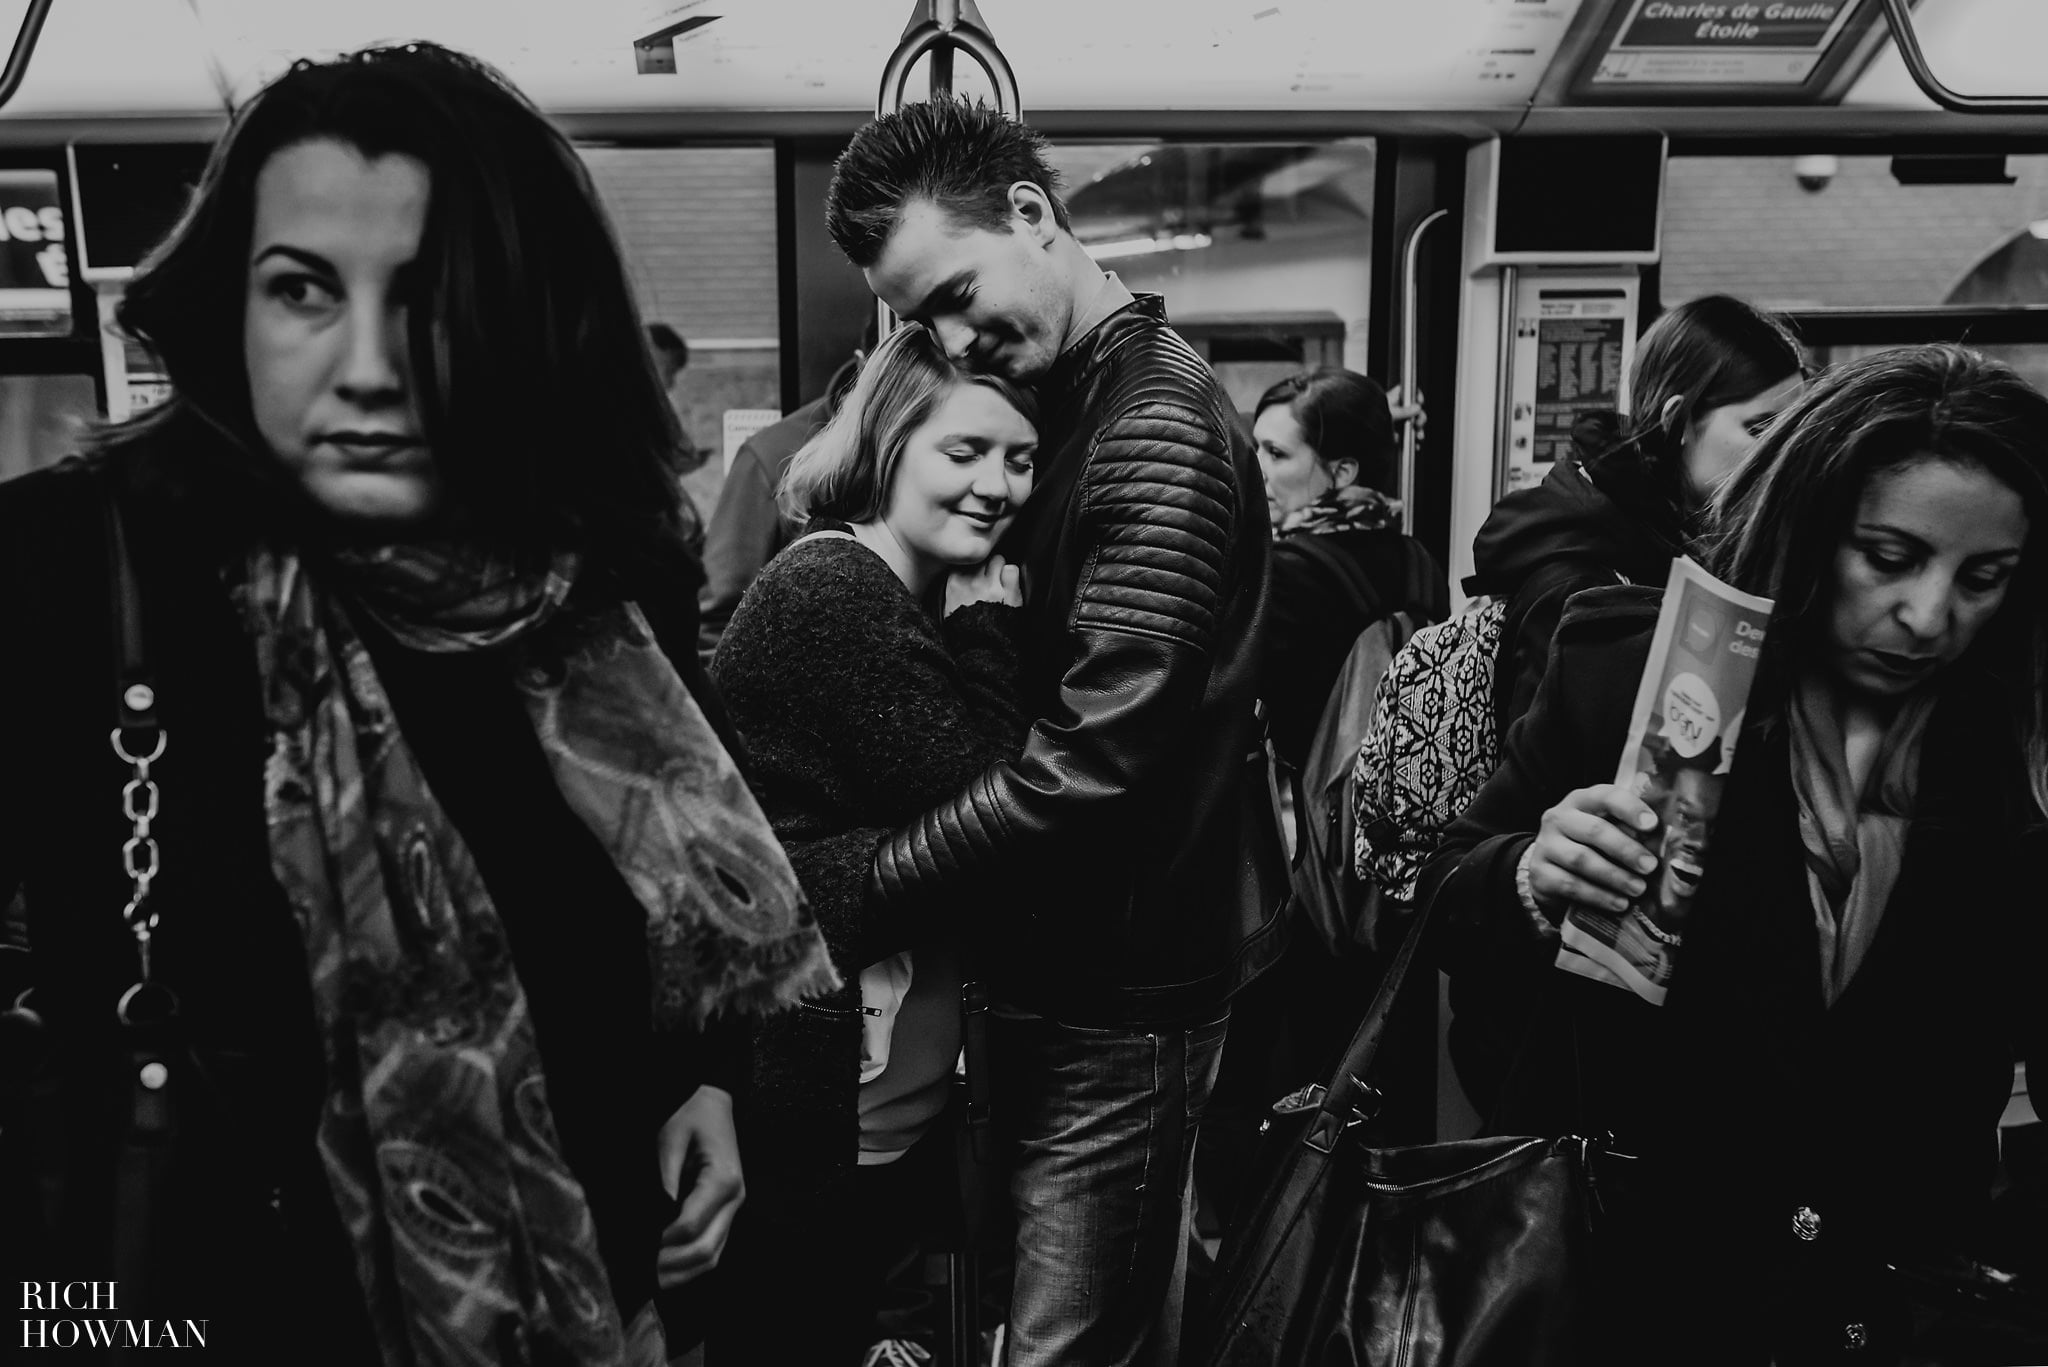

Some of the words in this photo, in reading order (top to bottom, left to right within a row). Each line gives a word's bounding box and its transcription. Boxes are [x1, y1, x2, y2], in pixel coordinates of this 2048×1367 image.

[1645, 2, 1727, 19] Charles
[1731, 3, 1760, 19] de
[1764, 3, 1834, 20] Gaulle
[1695, 19, 1760, 39] Étoile
